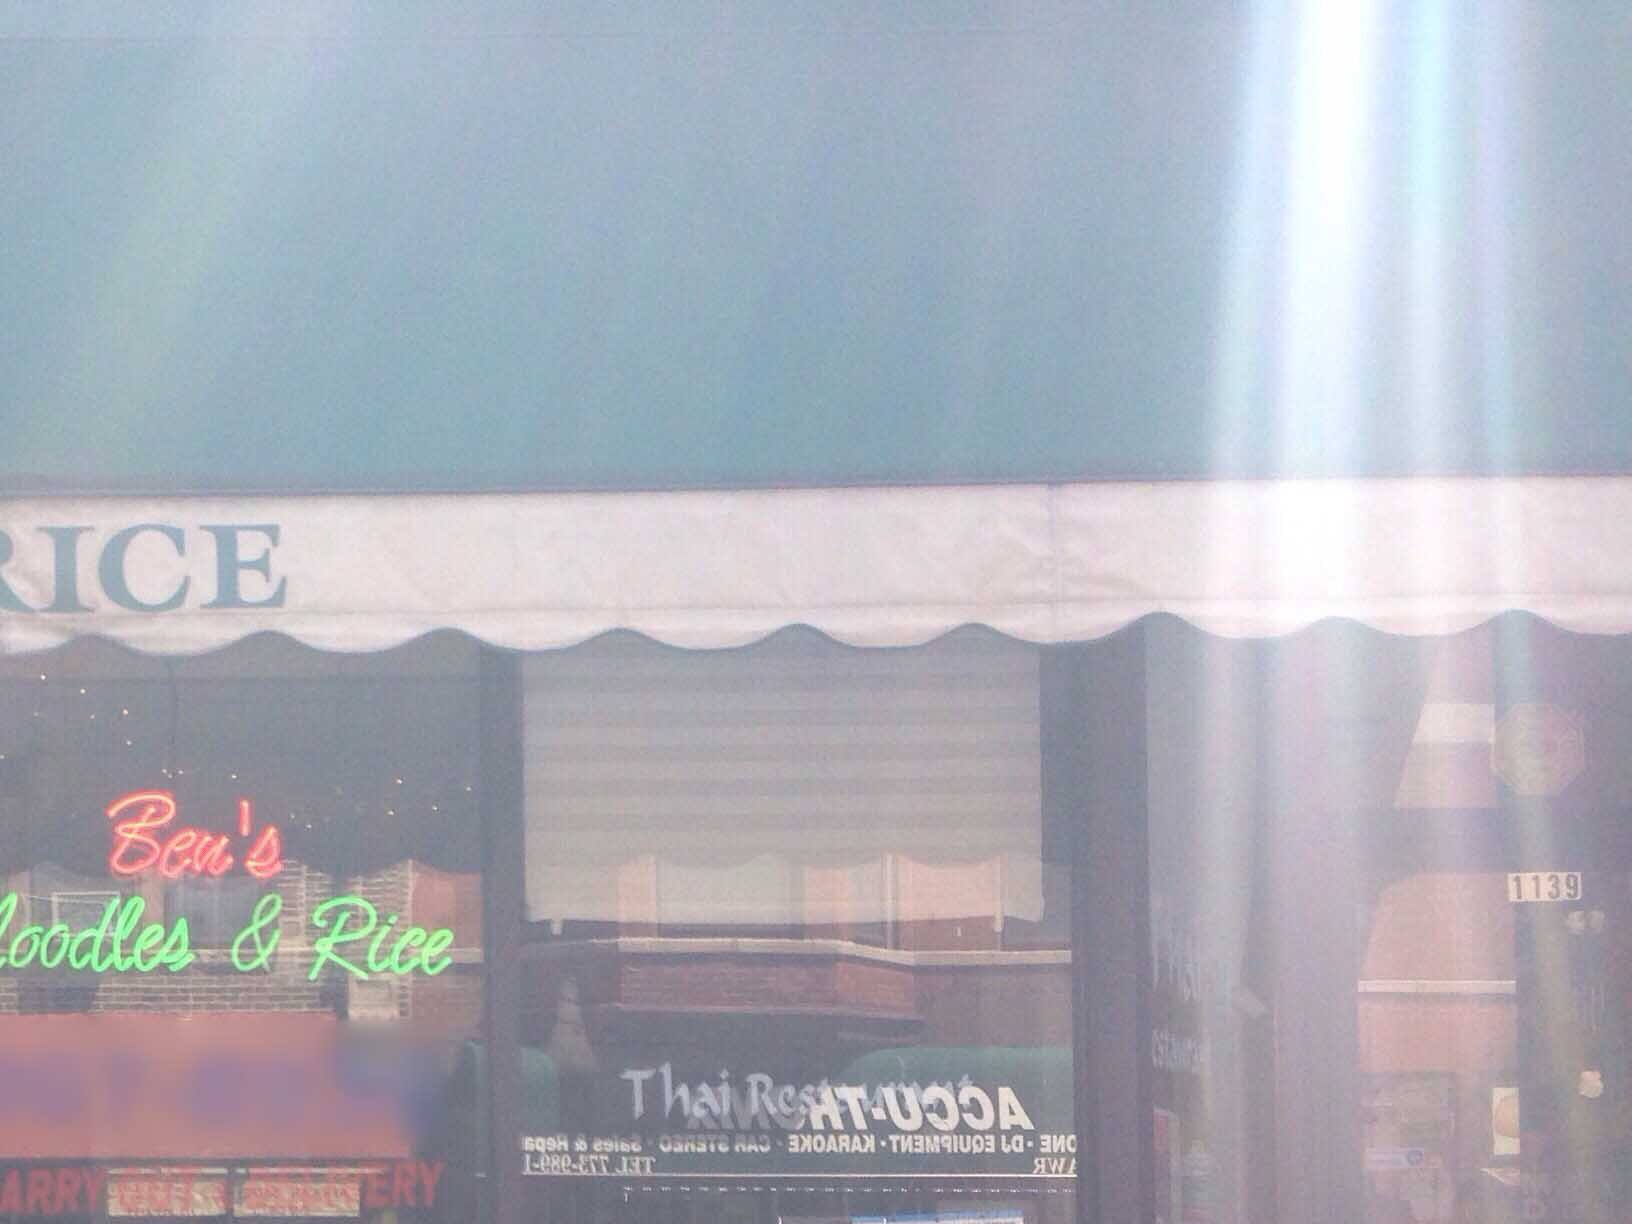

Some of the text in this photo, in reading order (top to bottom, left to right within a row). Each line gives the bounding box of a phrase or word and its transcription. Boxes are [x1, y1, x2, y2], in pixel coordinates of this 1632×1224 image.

[107, 790, 285, 879] Ben's
[1512, 873, 1579, 900] 1139
[232, 893, 284, 972] &
[308, 895, 455, 981] Rice
[620, 1061, 730, 1120] Thai
